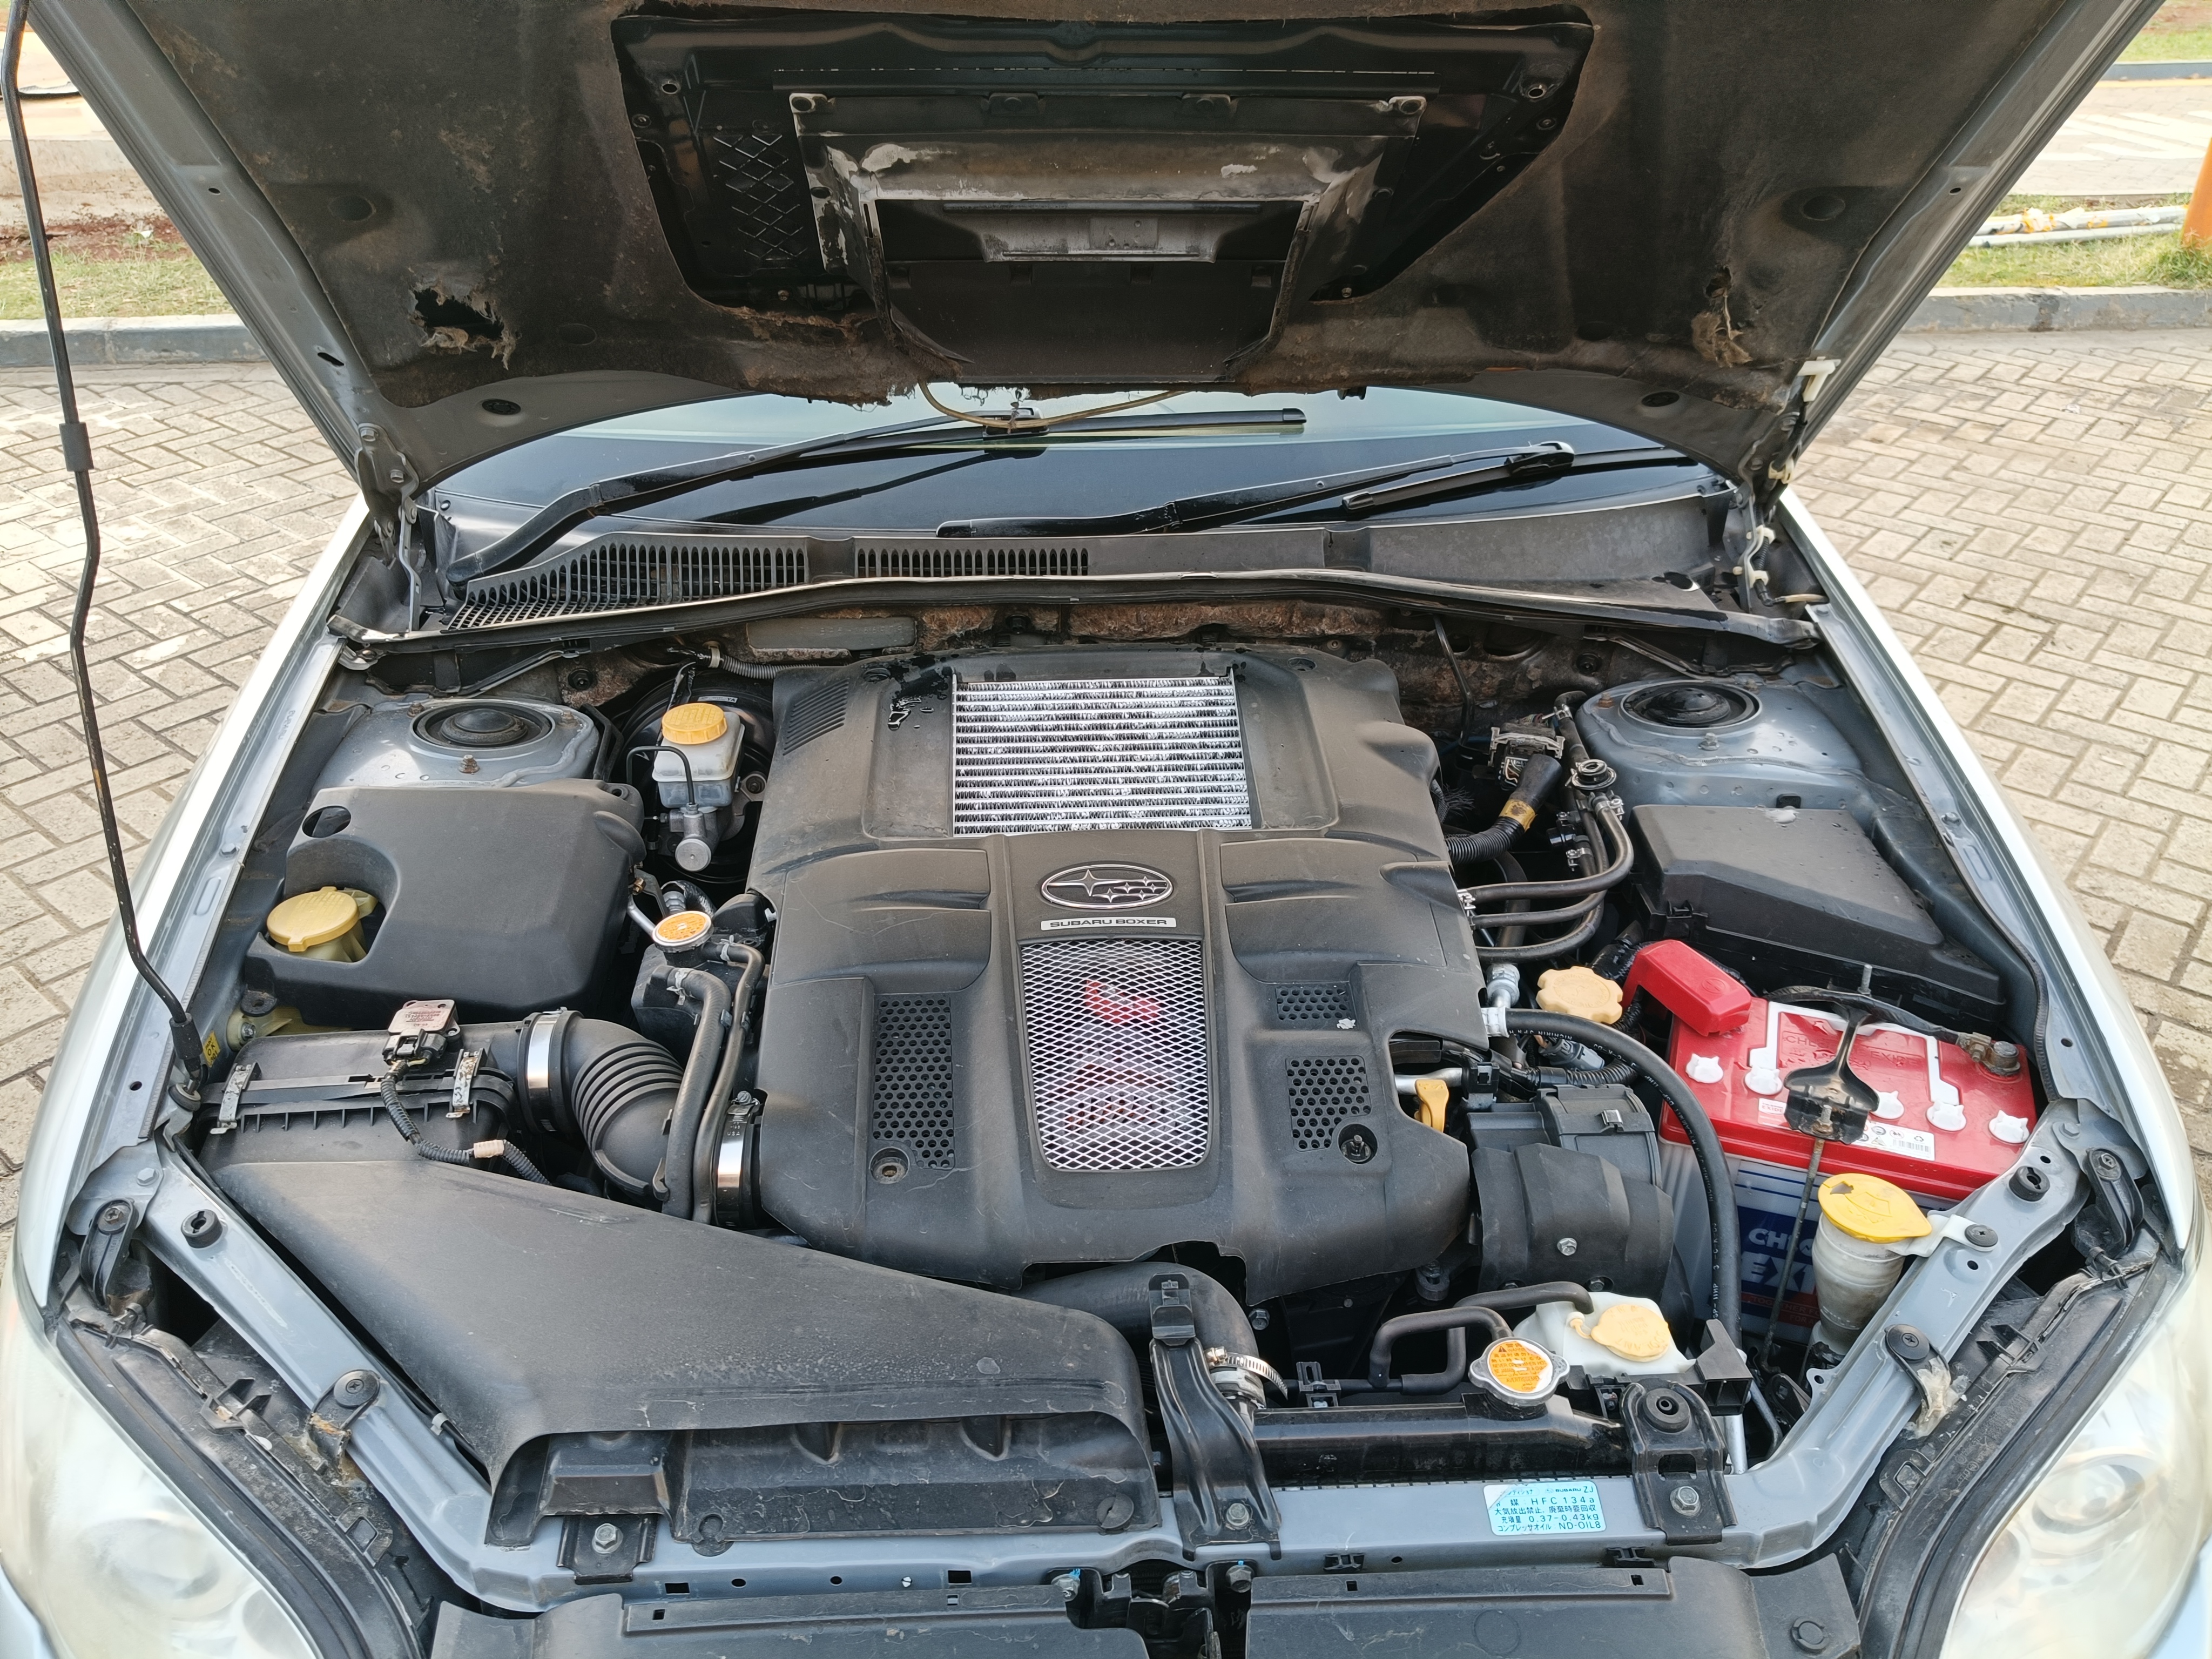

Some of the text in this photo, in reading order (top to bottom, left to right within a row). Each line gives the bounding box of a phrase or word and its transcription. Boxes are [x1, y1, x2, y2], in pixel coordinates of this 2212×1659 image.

[1050, 919, 1112, 927] SUBARU
[208, 1044, 215, 1056] OK
[1762, 1105, 1783, 1113] EXIDE
[1559, 1521, 1601, 1530] ND-OIL8
